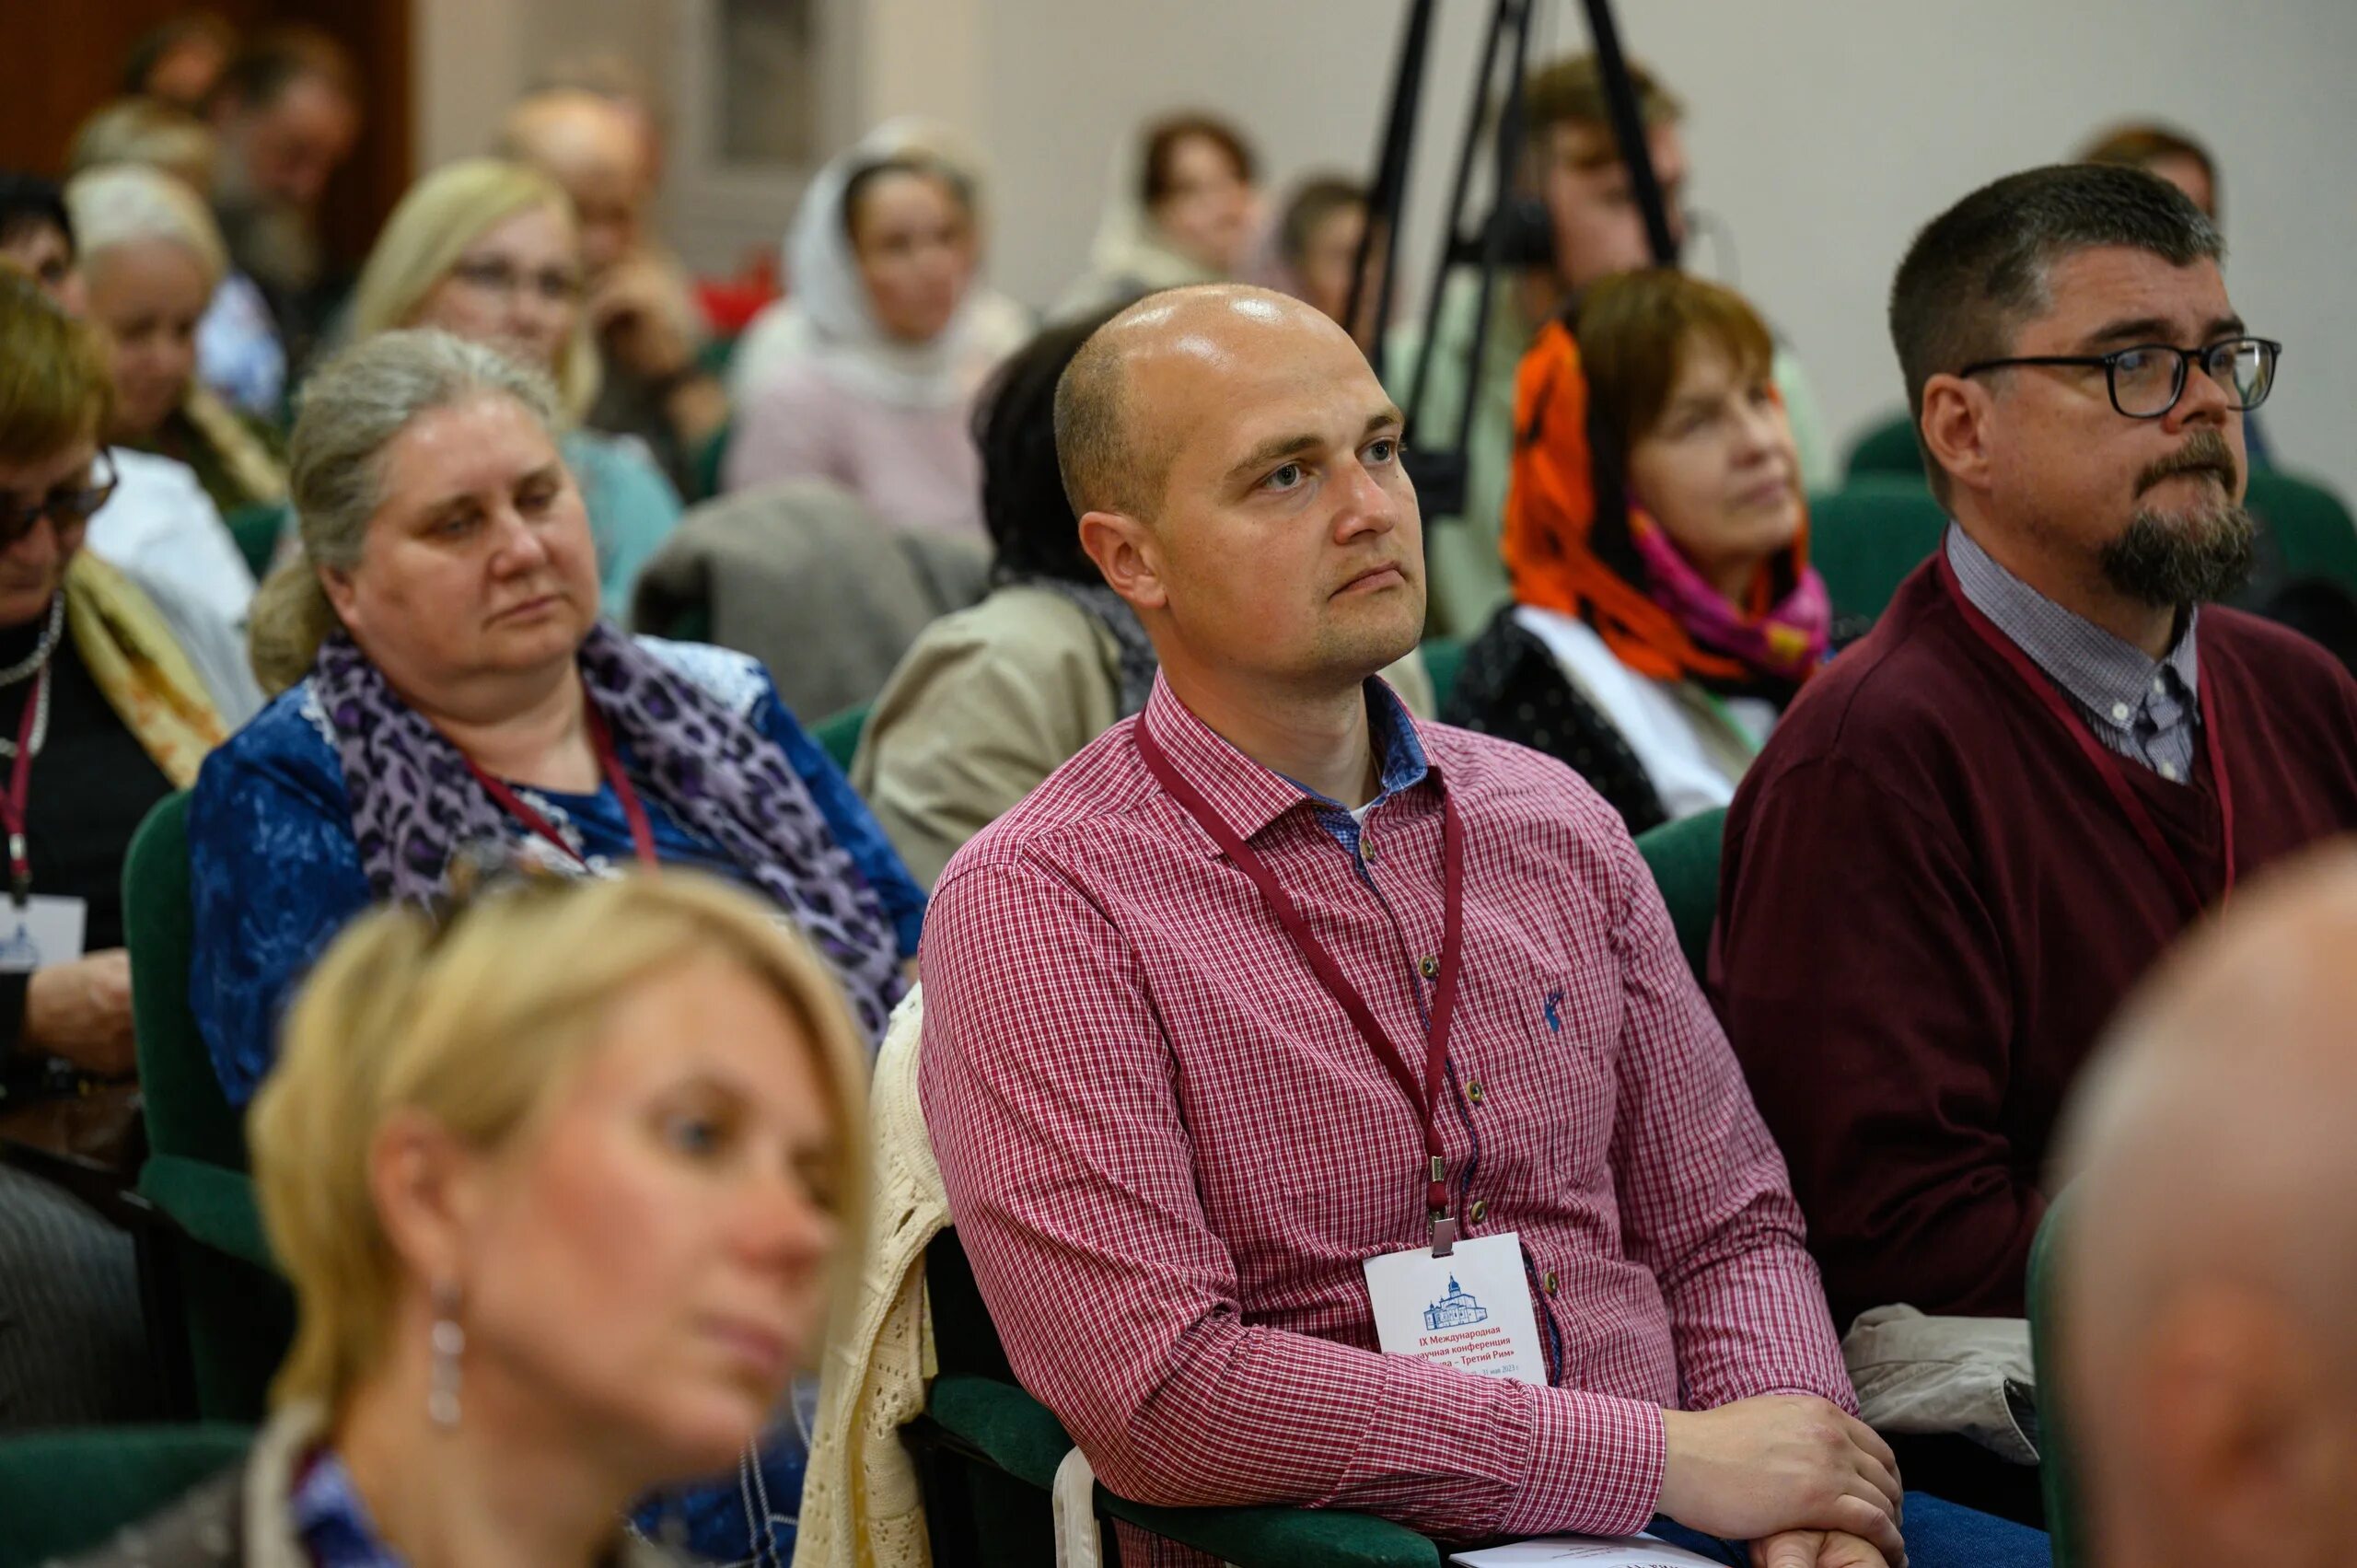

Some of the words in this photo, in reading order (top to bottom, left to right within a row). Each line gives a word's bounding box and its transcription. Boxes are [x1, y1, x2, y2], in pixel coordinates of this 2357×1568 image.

[1419, 1337, 1429, 1347] IX
[1430, 1326, 1501, 1344] Международная
[1452, 1337, 1511, 1353] конференция
[1461, 1352, 1492, 1365] Третий
[1493, 1350, 1515, 1359] Рим»
[1503, 1365, 1515, 1373] 2023
